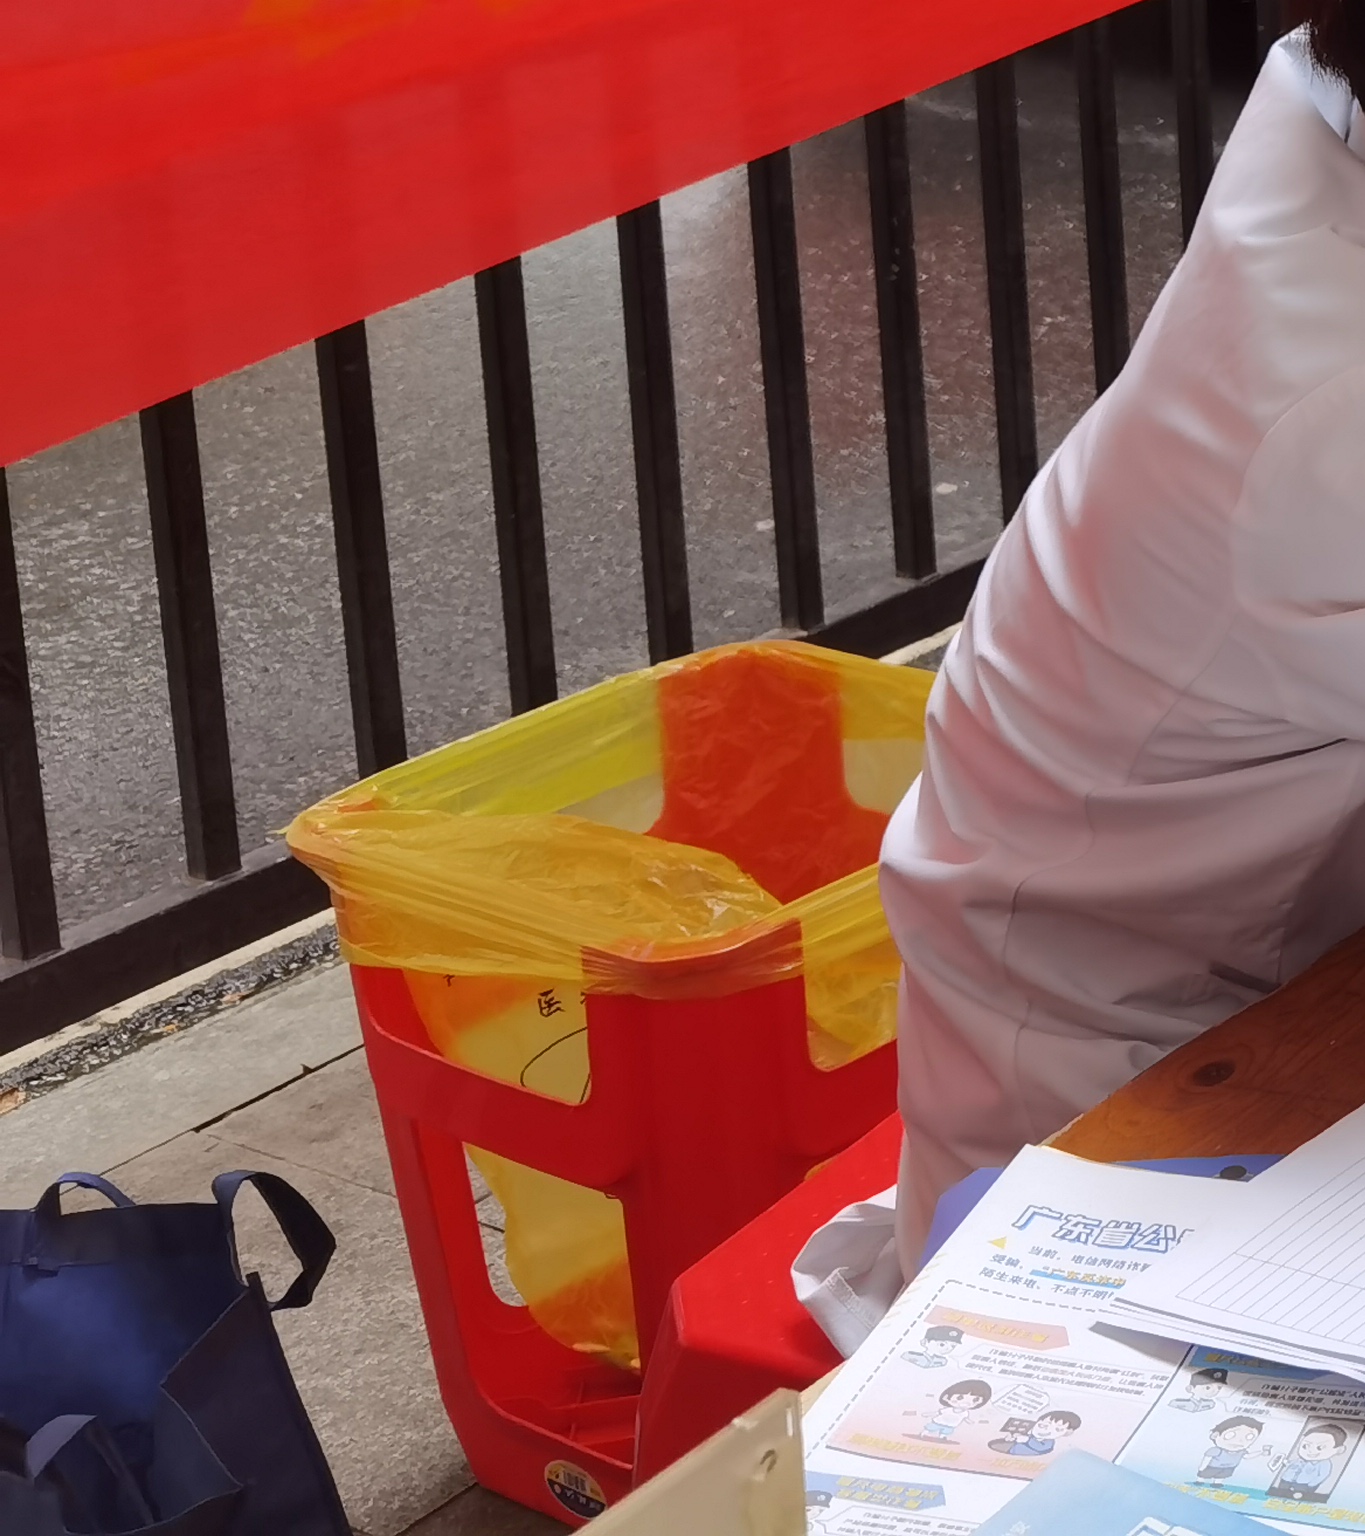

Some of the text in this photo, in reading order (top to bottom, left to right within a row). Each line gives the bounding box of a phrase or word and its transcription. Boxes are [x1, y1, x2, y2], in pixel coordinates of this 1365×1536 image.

[978, 1267, 1116, 1301] 陌生来电、不点不明
